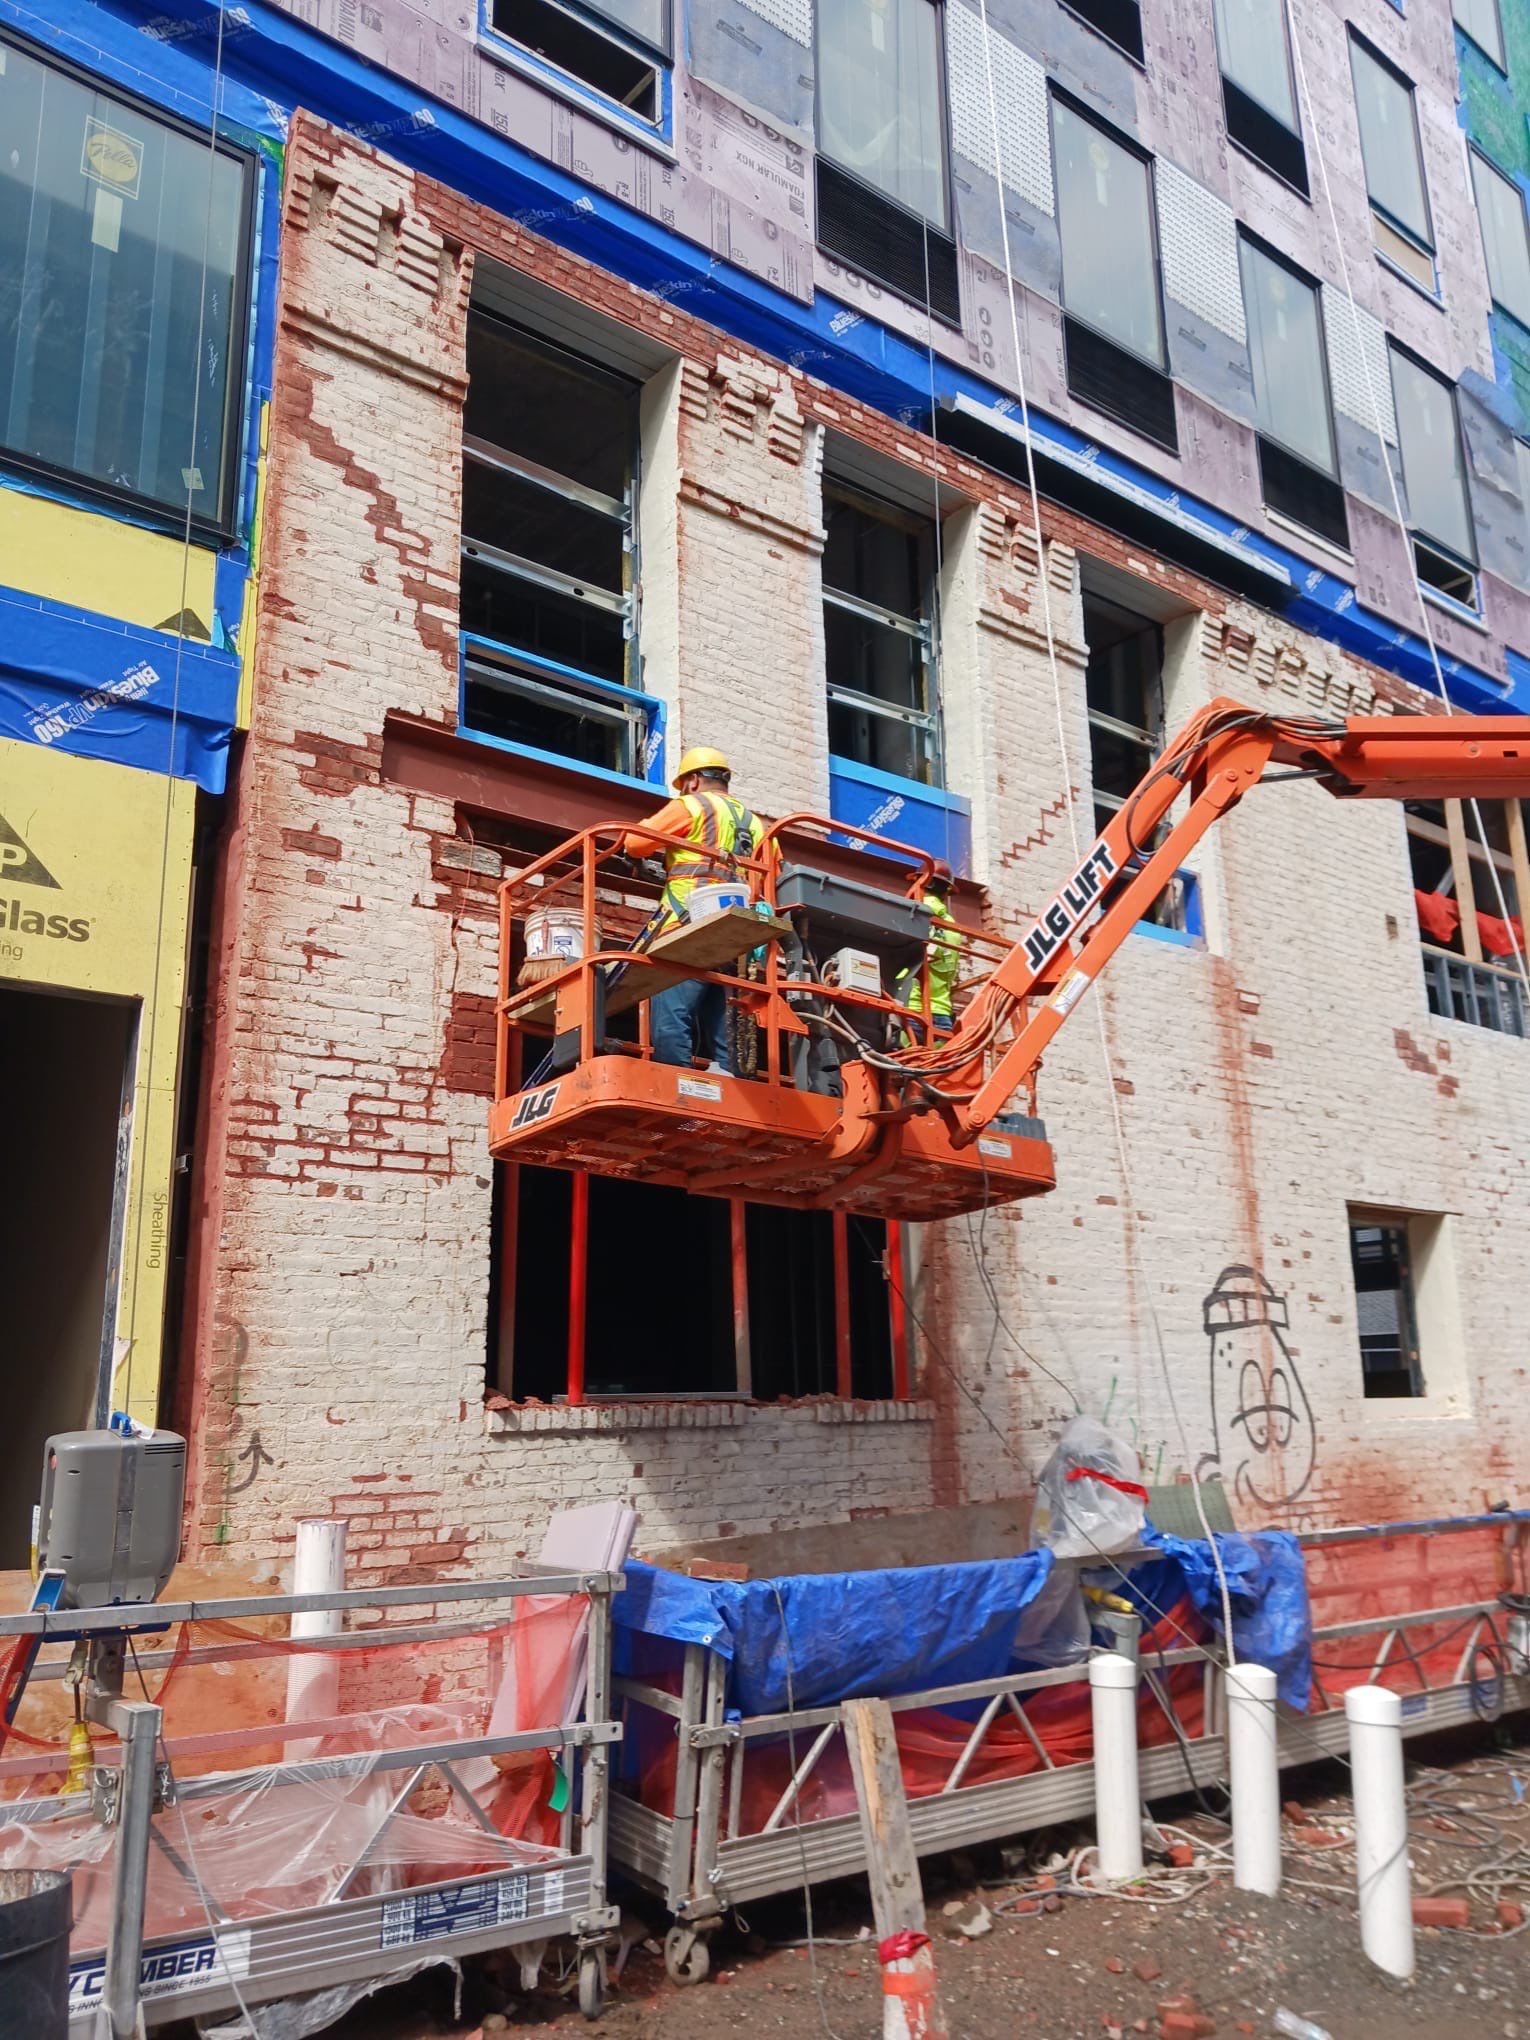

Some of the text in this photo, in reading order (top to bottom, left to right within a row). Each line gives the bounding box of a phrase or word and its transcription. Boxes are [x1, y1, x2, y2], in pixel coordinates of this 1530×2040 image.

[338, 0, 356, 41] OAMUL
[495, 111, 509, 134] 150
[90, 142, 137, 168] Pella
[735, 150, 806, 199] FOAMULAR NGX
[664, 207, 675, 227] 150
[0, 841, 28, 873] P
[1025, 901, 1072, 970] JLG
[1063, 844, 1115, 915] LIFT
[0, 940, 23, 960] ing
[511, 1085, 560, 1129] JLG
[146, 1193, 168, 1269] Sheathing
[153, 1979, 186, 1995] SINCE
